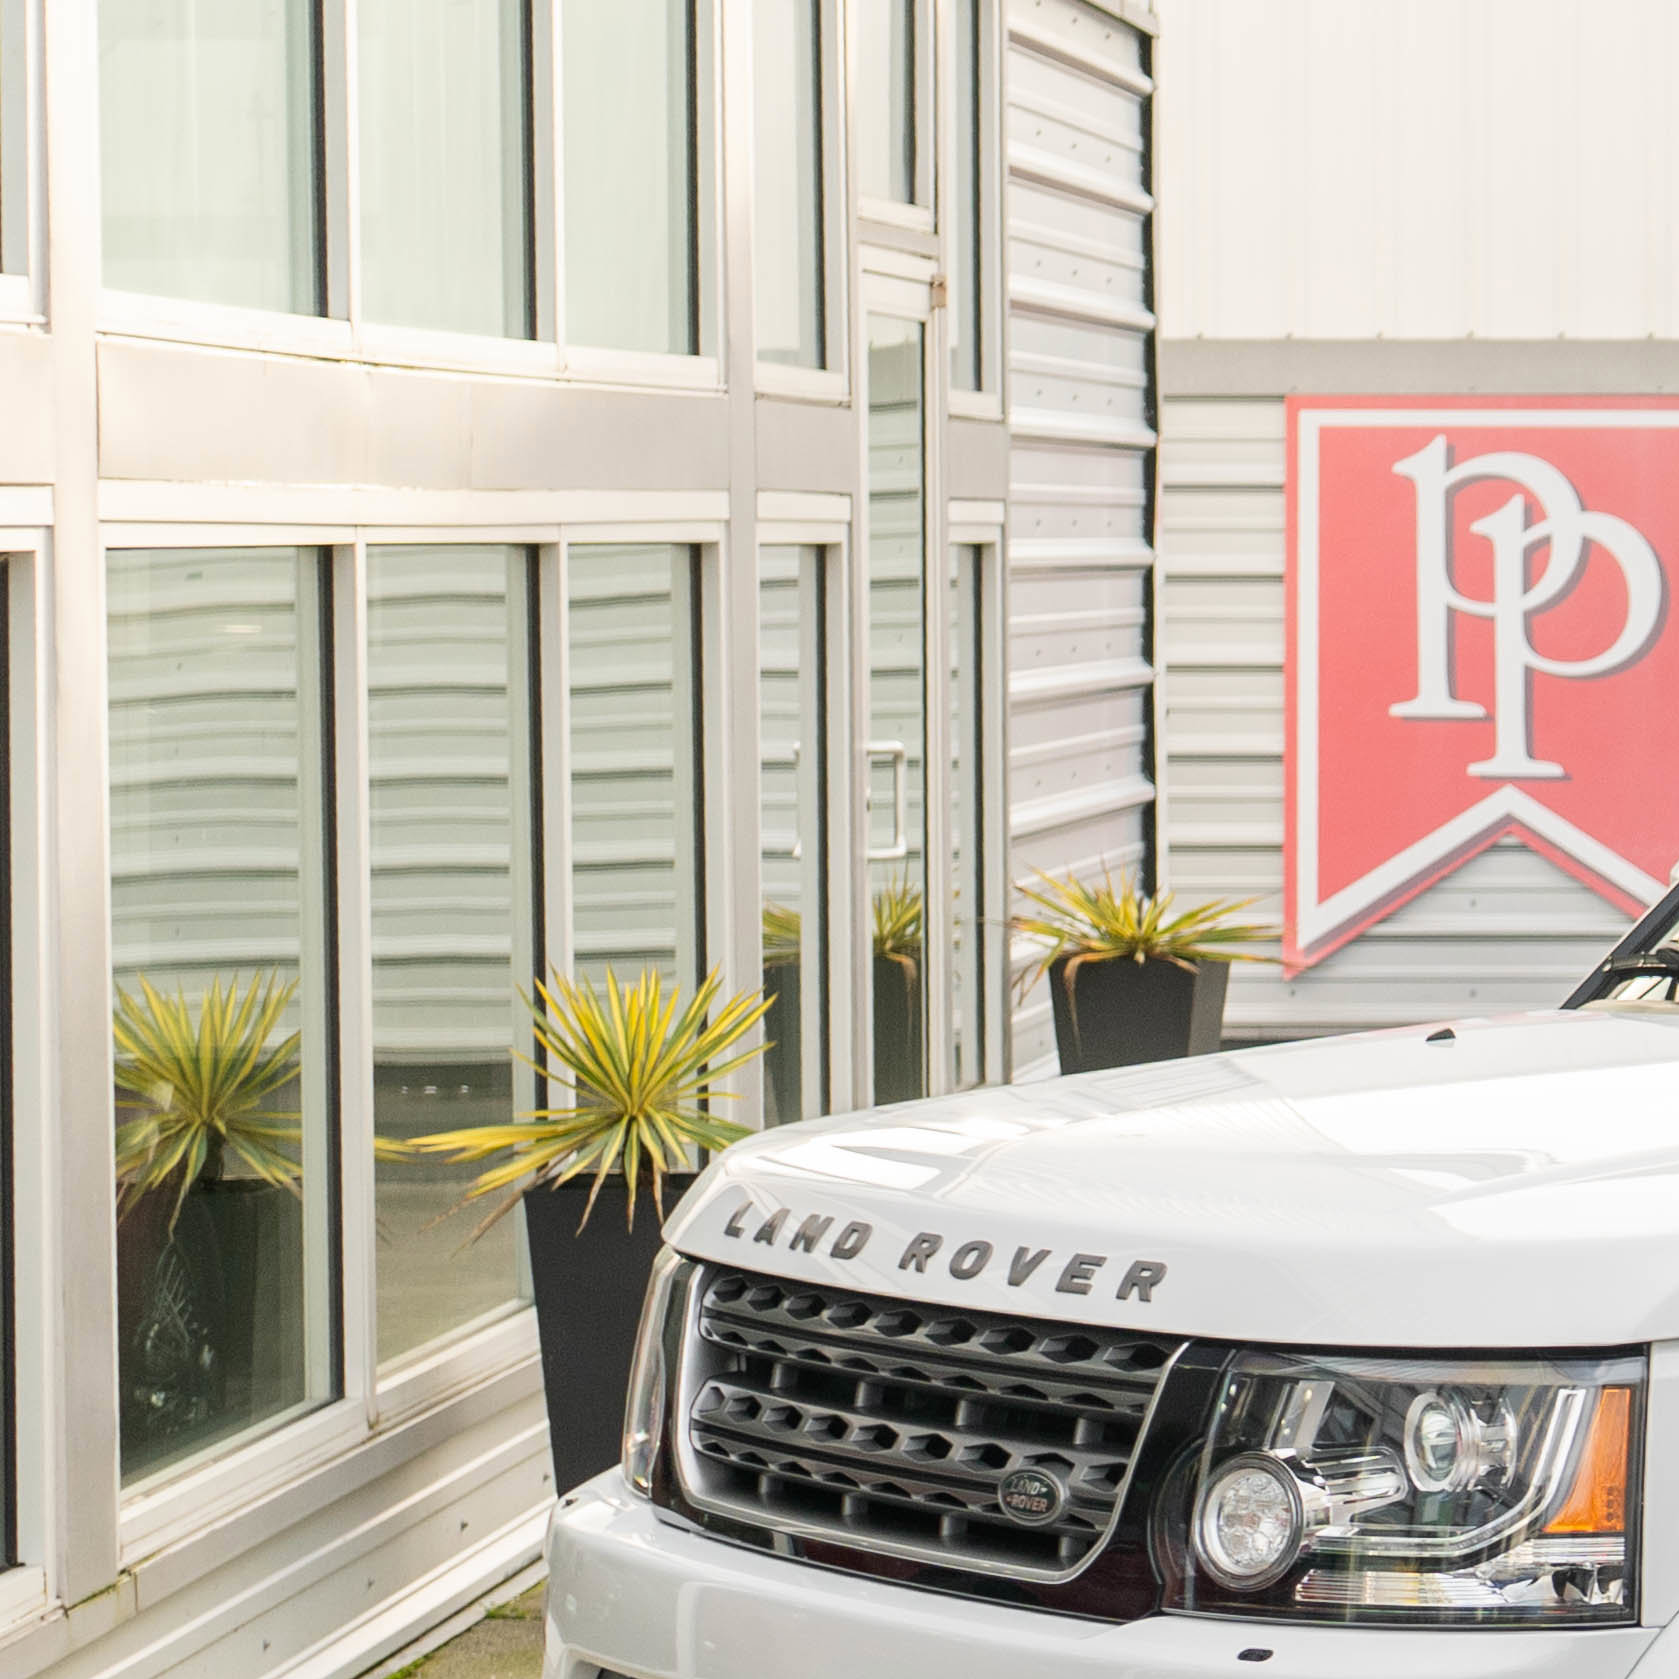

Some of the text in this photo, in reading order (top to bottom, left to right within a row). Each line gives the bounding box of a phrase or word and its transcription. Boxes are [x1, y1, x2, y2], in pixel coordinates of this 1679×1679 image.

[723, 1200, 1168, 1303] LAND ROVER
[1010, 1493, 1048, 1513] ROVER
